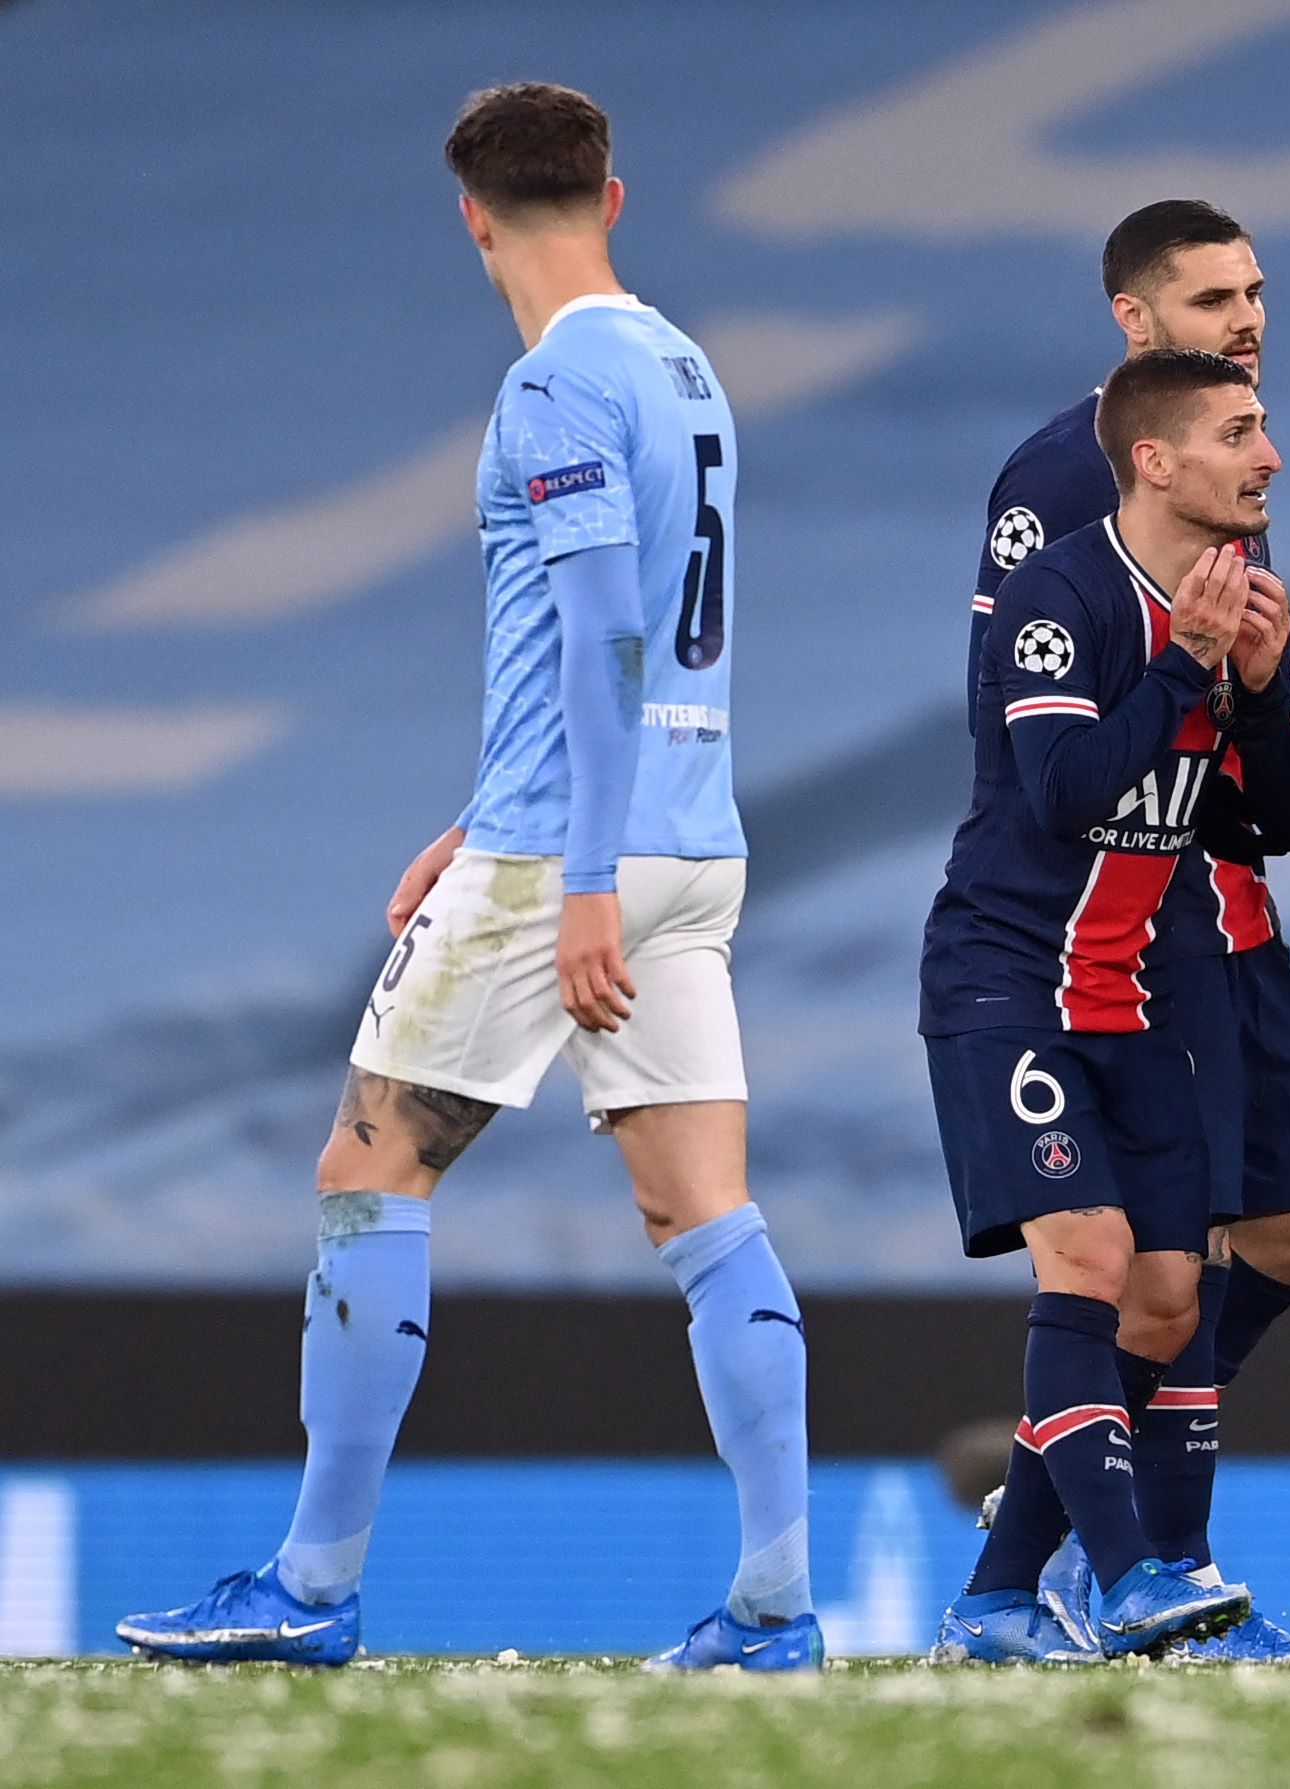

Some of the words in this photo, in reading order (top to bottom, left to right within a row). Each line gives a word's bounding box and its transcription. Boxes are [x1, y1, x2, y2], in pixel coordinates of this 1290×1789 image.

[545, 468, 604, 490] RESPECT
[674, 434, 724, 671] 5
[1120, 831, 1159, 850] LIVE
[382, 913, 433, 992] 5
[1010, 1049, 1065, 1124] 6
[1037, 1133, 1069, 1148] PARIS
